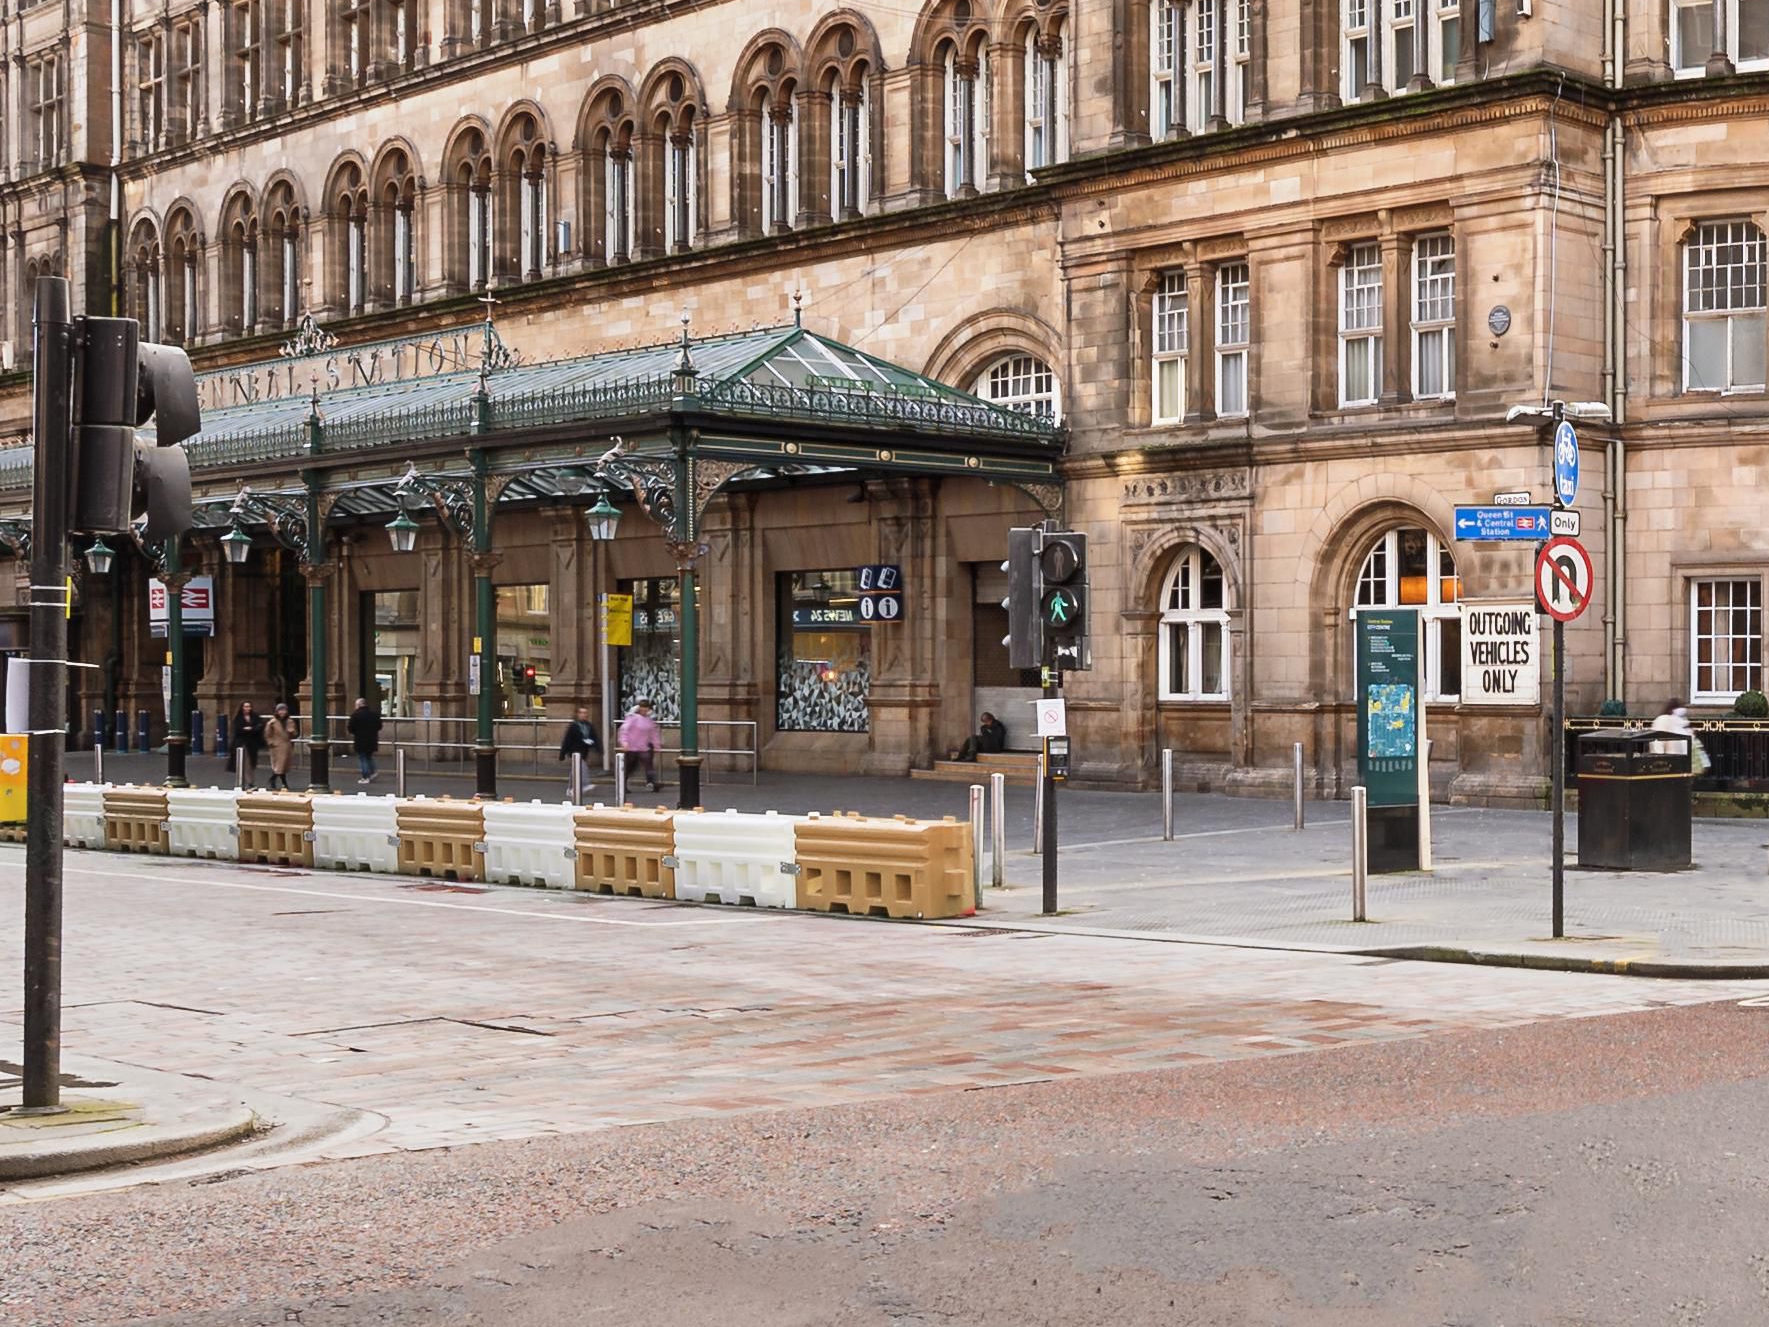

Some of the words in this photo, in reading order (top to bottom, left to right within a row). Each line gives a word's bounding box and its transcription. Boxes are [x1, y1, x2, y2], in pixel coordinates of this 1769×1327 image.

[196, 363, 302, 411] ENTRAL
[325, 333, 470, 392] STATION
[1477, 510, 1503, 520] Queen
[1484, 519, 1514, 528] Central
[1555, 517, 1576, 531] Only
[1480, 527, 1510, 536] Station
[1469, 611, 1531, 635] OUTGOING
[1469, 640, 1529, 665] VEHICLES
[1482, 669, 1518, 693] ONLY
